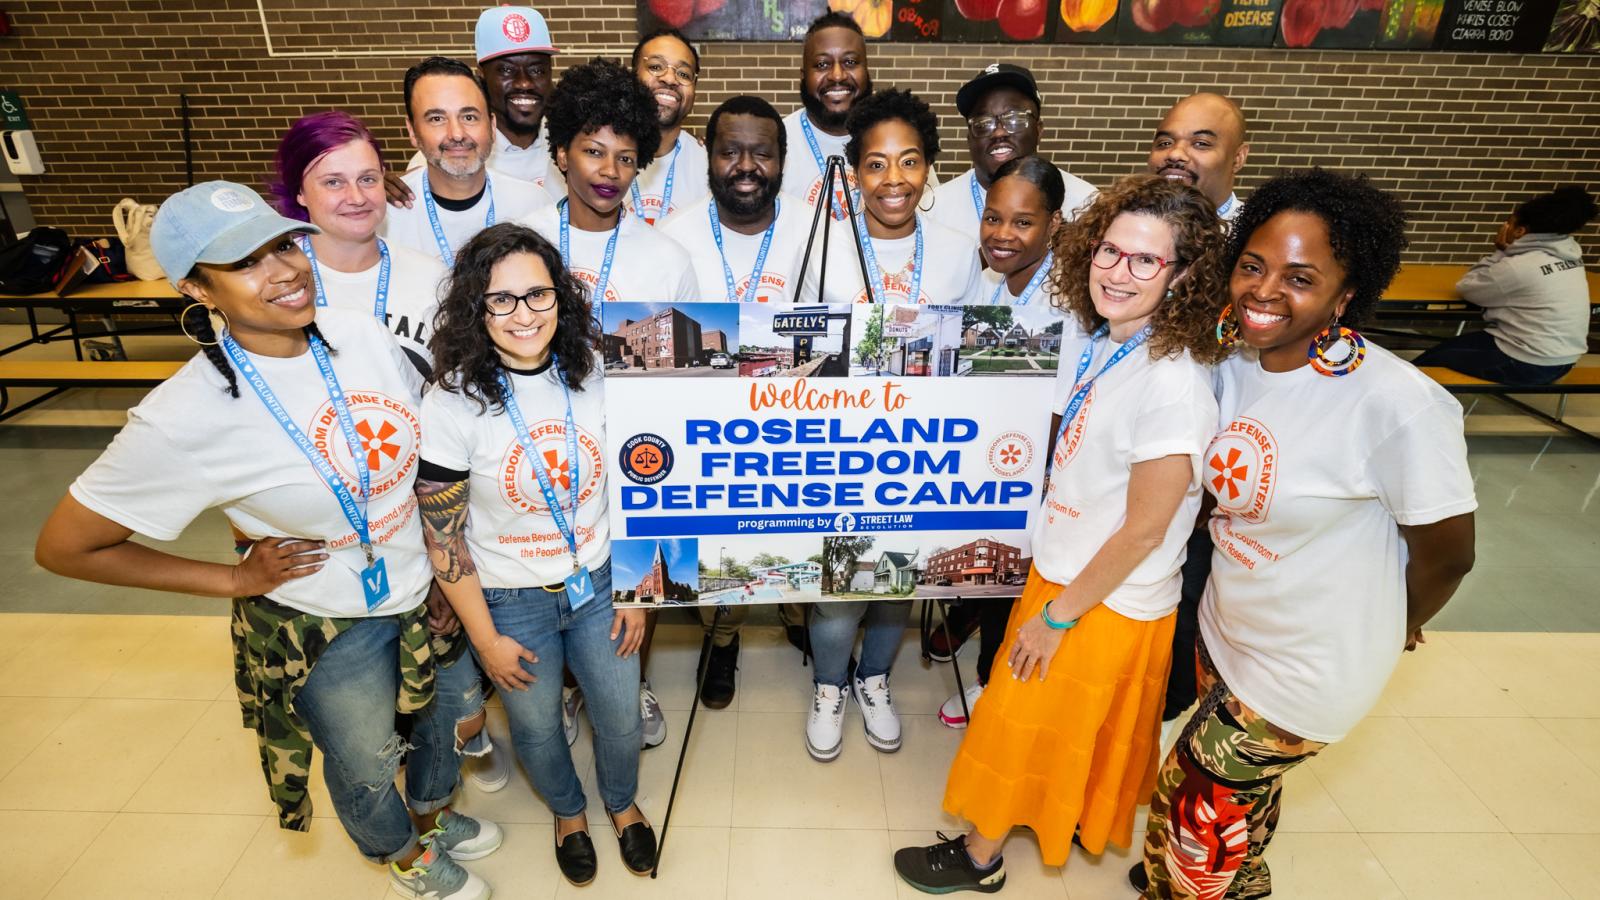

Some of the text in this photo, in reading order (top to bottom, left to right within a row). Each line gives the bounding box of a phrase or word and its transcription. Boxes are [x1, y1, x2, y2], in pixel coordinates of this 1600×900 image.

[1224, 10, 1275, 28] DISEASE
[1487, 14, 1520, 26] COSEY
[1488, 29, 1514, 41] BOYD
[755, 239, 769, 270] VOLUNTEER
[864, 243, 879, 281] VOLUNTEER
[1540, 263, 1554, 276] IN
[774, 315, 826, 329] GATELYS
[311, 340, 337, 390] VOLUNTEER
[749, 378, 912, 412] Welcome to
[320, 394, 421, 440] DEENSE CENTER
[335, 399, 360, 452] VOLUNTEER
[627, 435, 666, 449] COOK COUNTY
[686, 418, 978, 445] ROSELAND
[1067, 407, 1087, 459] CENTER
[250, 373, 289, 423] VOLUNTEER
[294, 431, 336, 479] VOLUNTEER
[338, 487, 364, 530] VOLUNTEER
[701, 450, 960, 477] FREEDOM
[504, 443, 526, 504] FREEDOM
[579, 434, 602, 480] CENTER
[527, 446, 551, 490] VOLUNTEER
[1225, 421, 1274, 512] EFENSE CENTER
[621, 482, 871, 510] DEFENSE
[875, 480, 1032, 506] CAMP
[367, 507, 399, 533] Beyond
[737, 514, 913, 531] programming by STREET LAW
[1068, 506, 1081, 519] for
[378, 524, 401, 545] People
[498, 534, 530, 545] Defense
[531, 531, 562, 544] Beyond
[1235, 532, 1273, 561] Courtroom
[520, 548, 534, 558] the
[535, 546, 563, 558] People
[1226, 543, 1256, 570] Roseland
